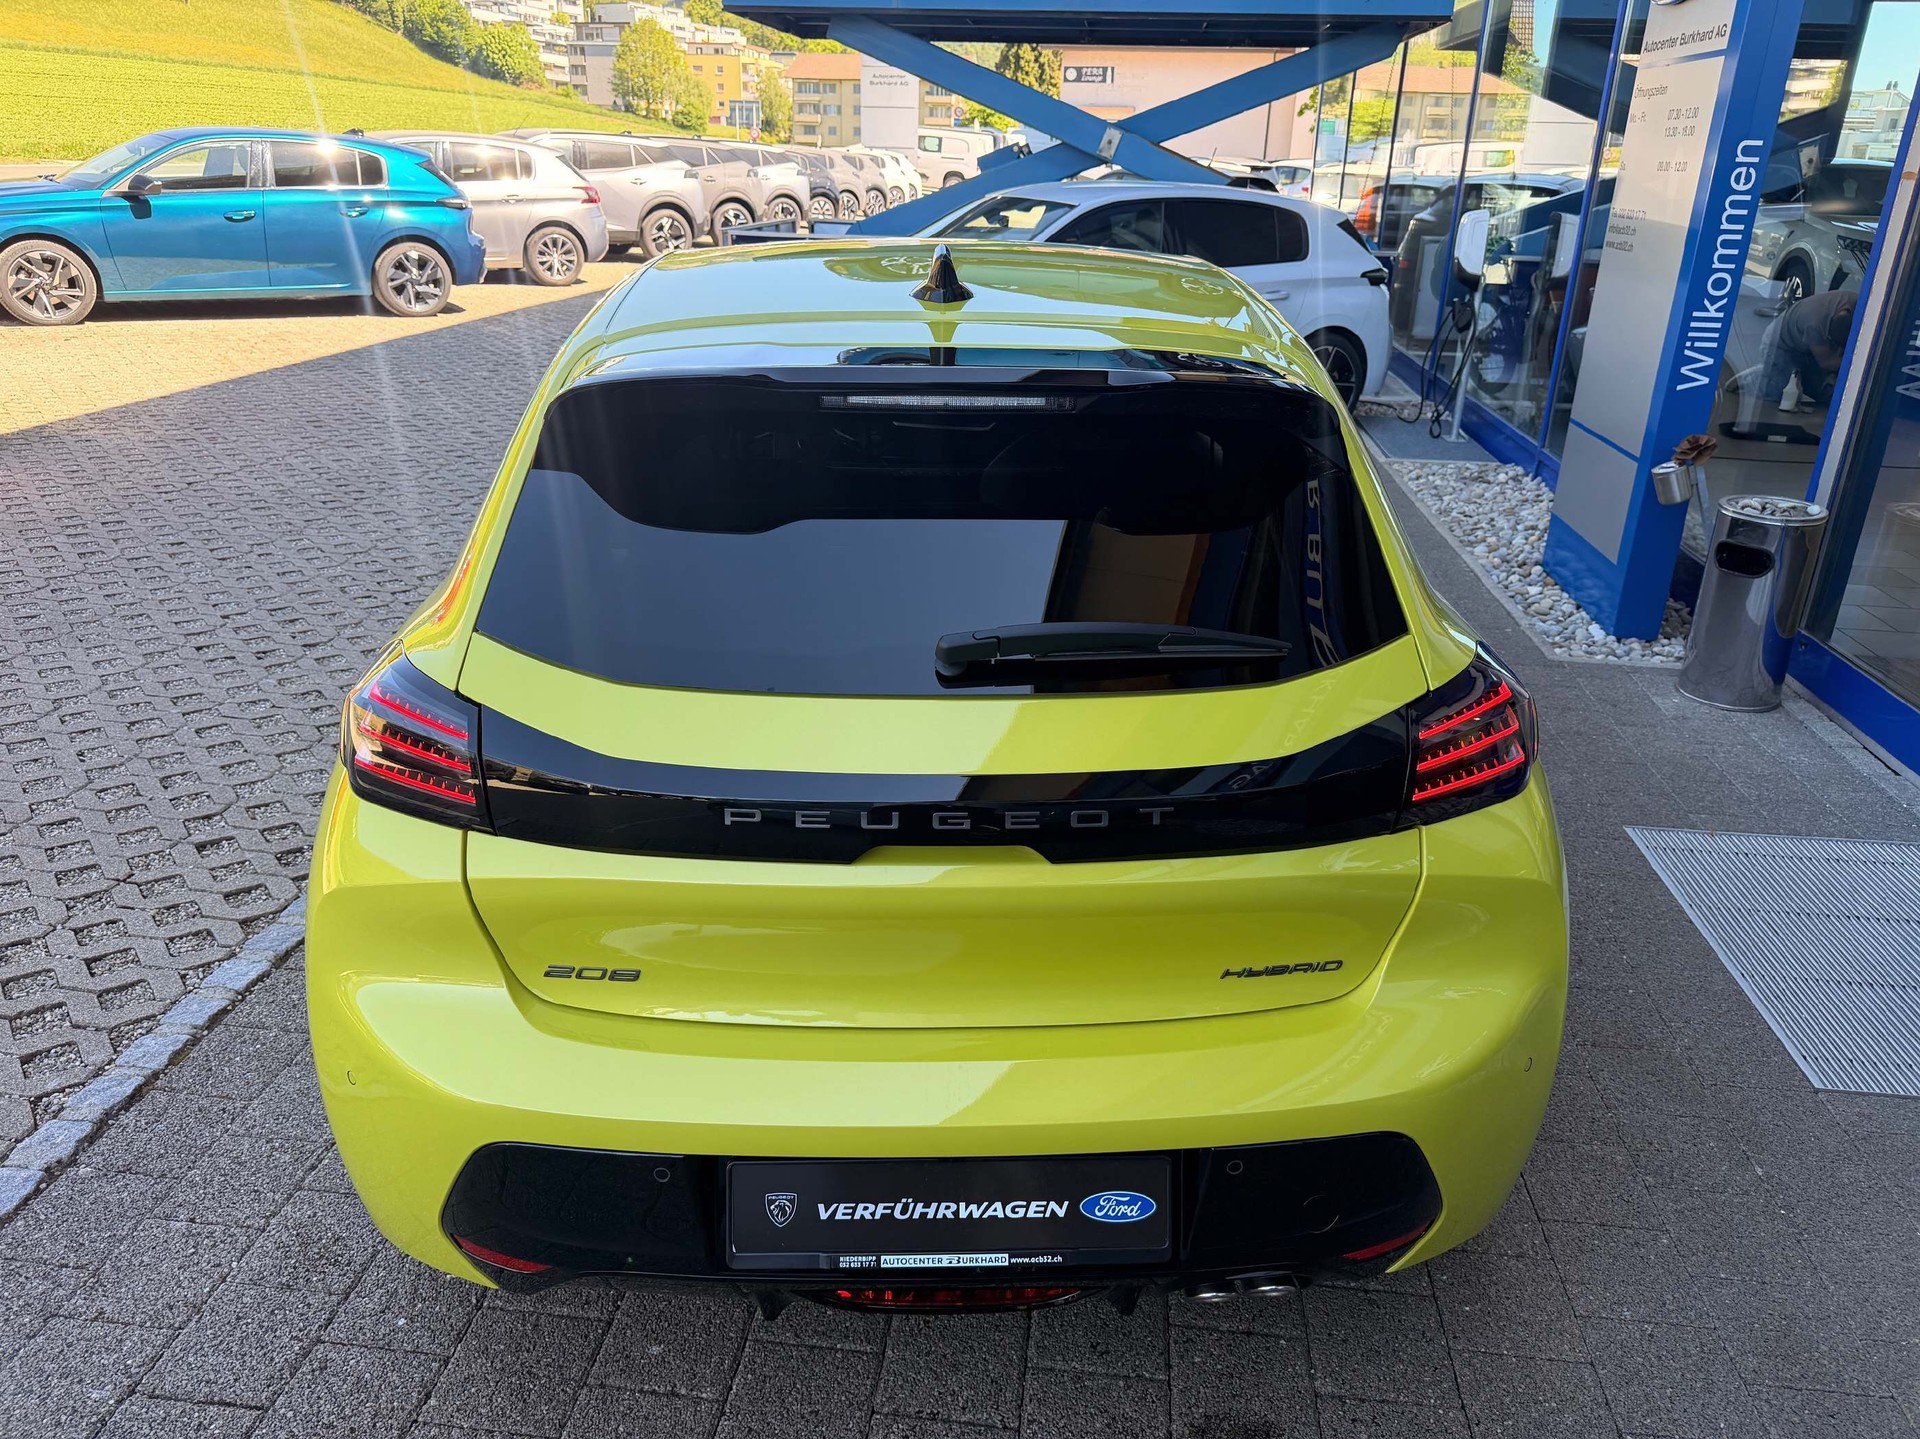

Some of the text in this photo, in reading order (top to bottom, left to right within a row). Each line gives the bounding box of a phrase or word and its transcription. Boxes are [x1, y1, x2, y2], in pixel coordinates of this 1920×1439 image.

[1643, 23, 1728, 54] Autocenter Burkhard AG
[1684, 106, 1700, 119] 12.00
[1674, 161, 1688, 172] 12.00
[1676, 139, 1764, 391] Willkommen
[724, 807, 1175, 830] PEUGEOT
[543, 964, 641, 982] 208
[1219, 959, 1344, 980] HYBRID
[817, 1197, 1069, 1220] VERFÜHRWAGEN
[1094, 1195, 1142, 1217] Ford
[882, 1255, 1007, 1266] AUTOCENTER BURKHARD
[1010, 1254, 1063, 1264] www.acb32.ch
